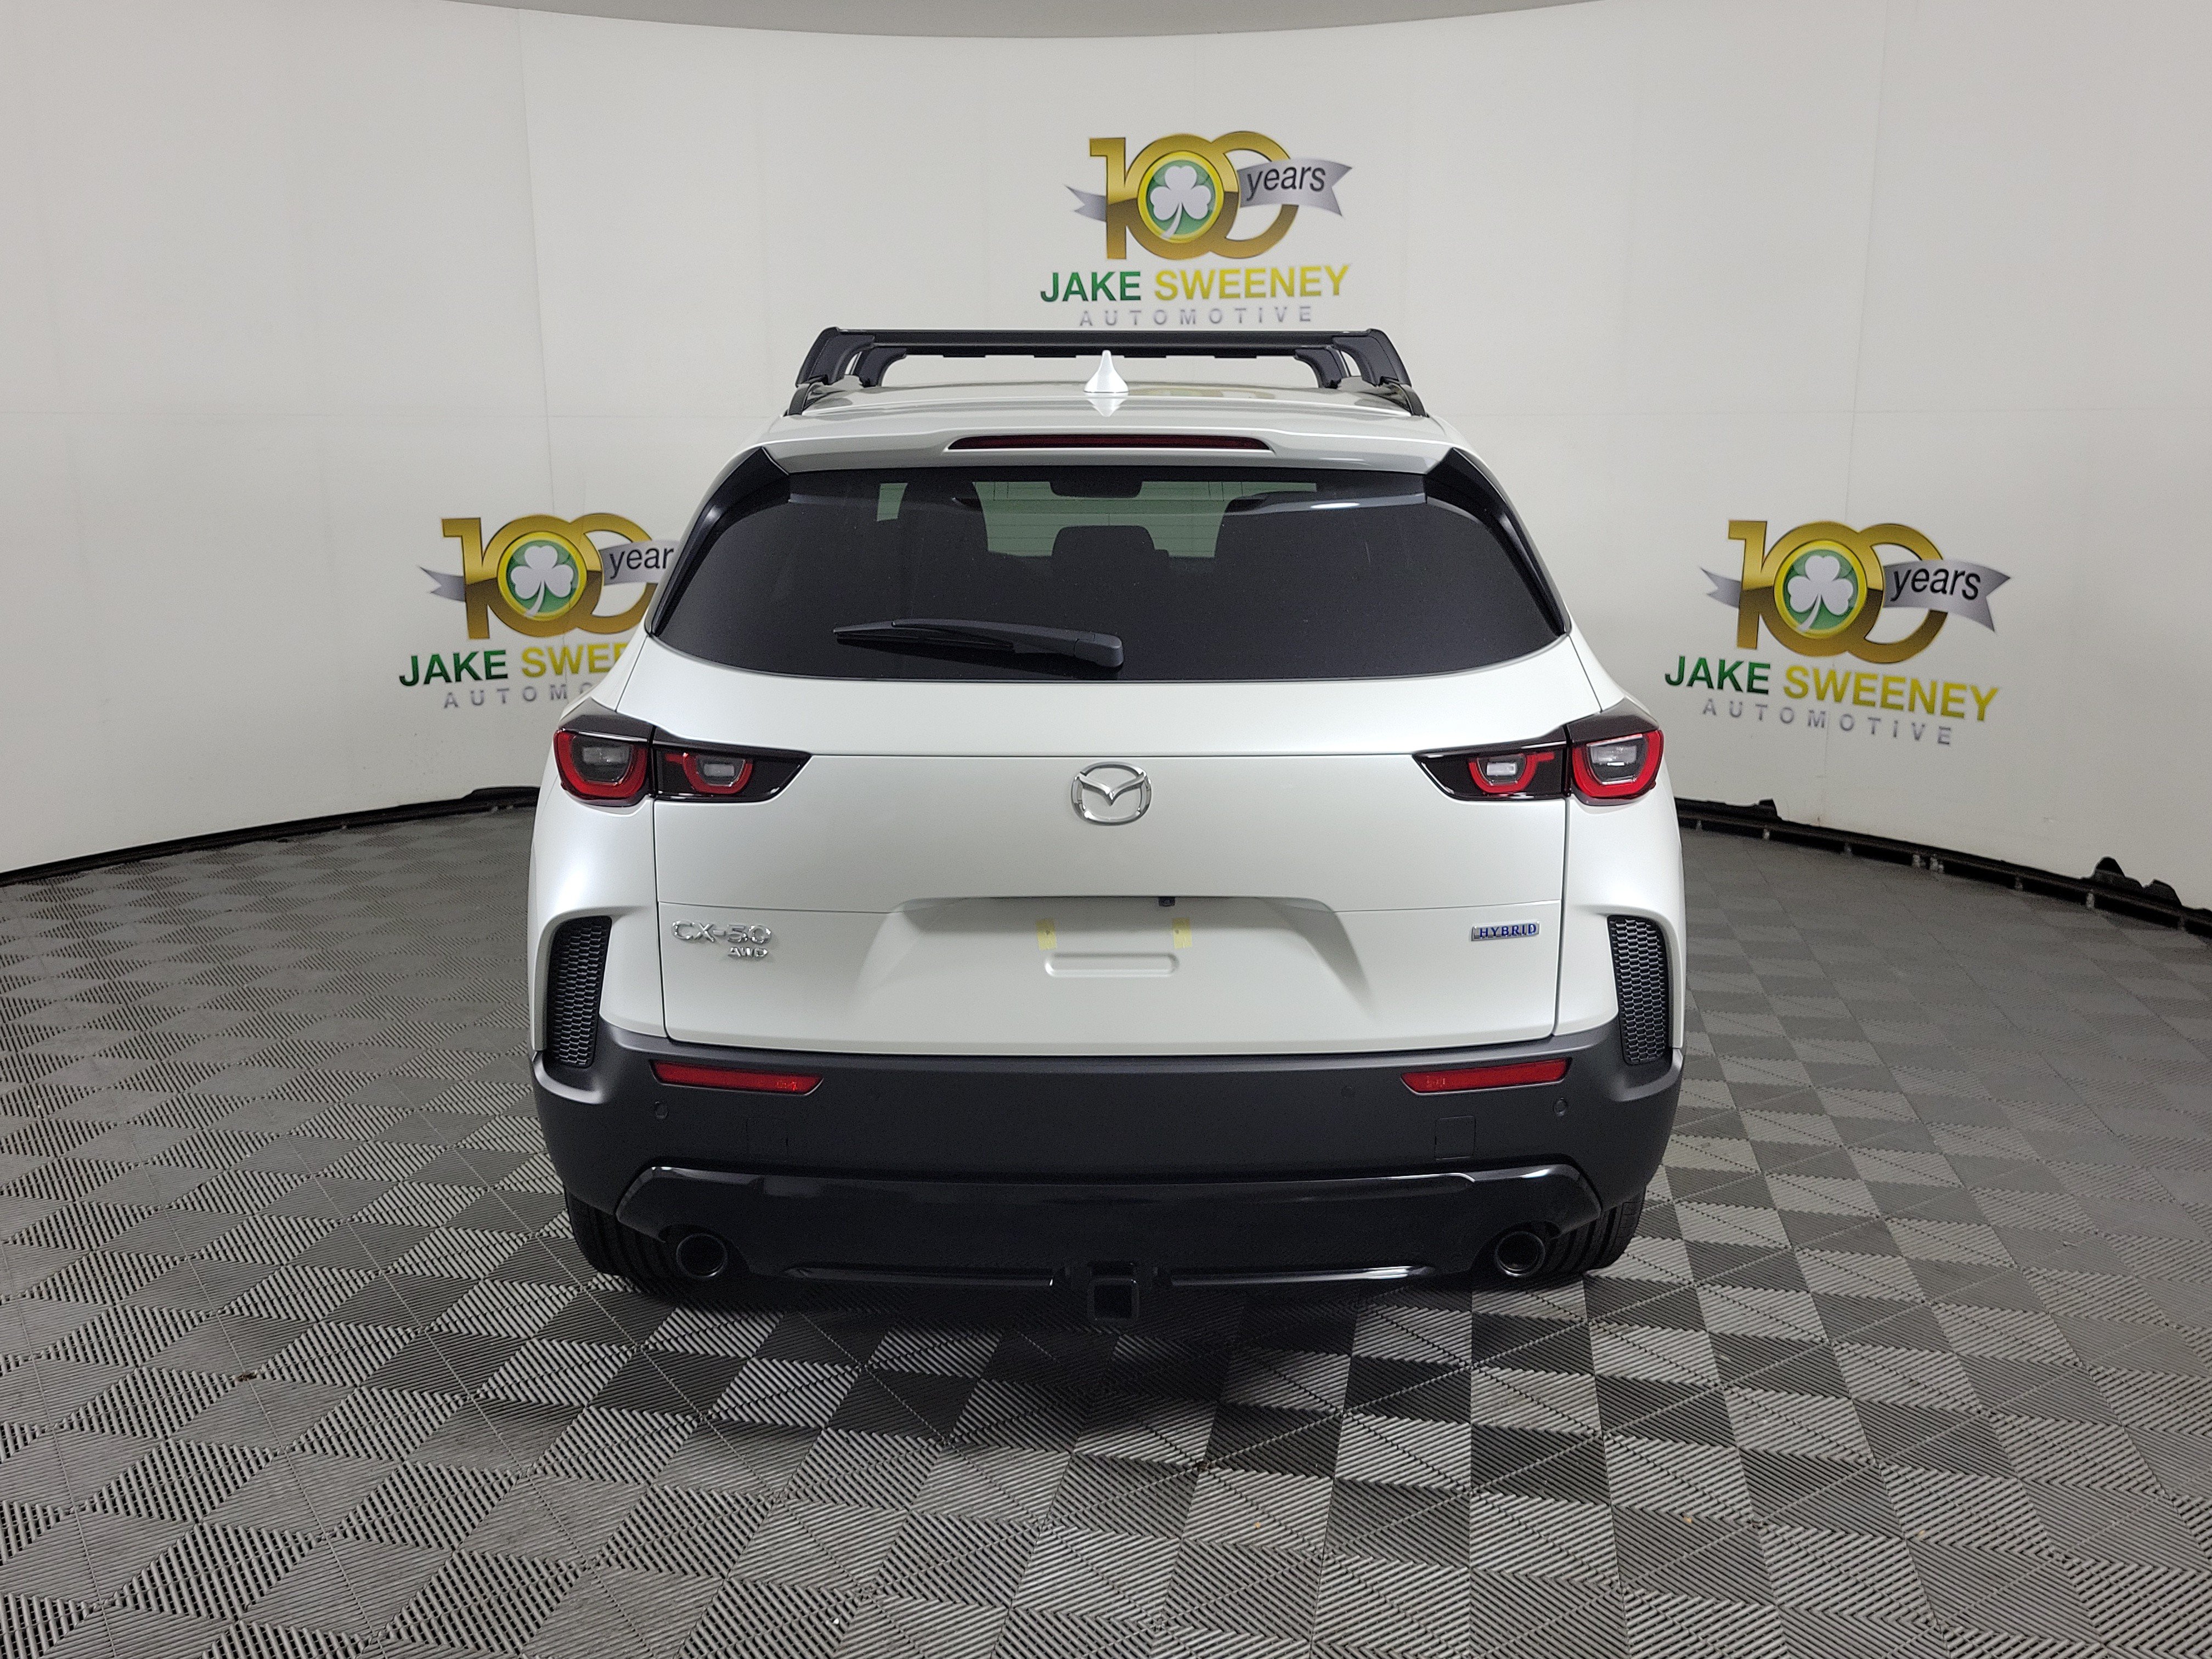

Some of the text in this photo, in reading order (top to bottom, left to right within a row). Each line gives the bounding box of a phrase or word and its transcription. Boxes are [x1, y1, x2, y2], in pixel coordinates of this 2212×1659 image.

[1090, 131, 1327, 260] 100 years
[1040, 265, 1350, 303] JAKE SWEENEY
[1080, 306, 1312, 327] AUTOMOTIVE
[442, 513, 674, 639] 100 year
[1728, 520, 1980, 664] 100 years
[399, 649, 509, 687] JAKE
[1664, 655, 1998, 721] JAKE SWEENEY
[1702, 698, 1952, 746] AUTOMOTIVE
[671, 920, 772, 944] CX-50
[1480, 923, 1537, 938] HYBRID
[728, 946, 768, 958] AWD
